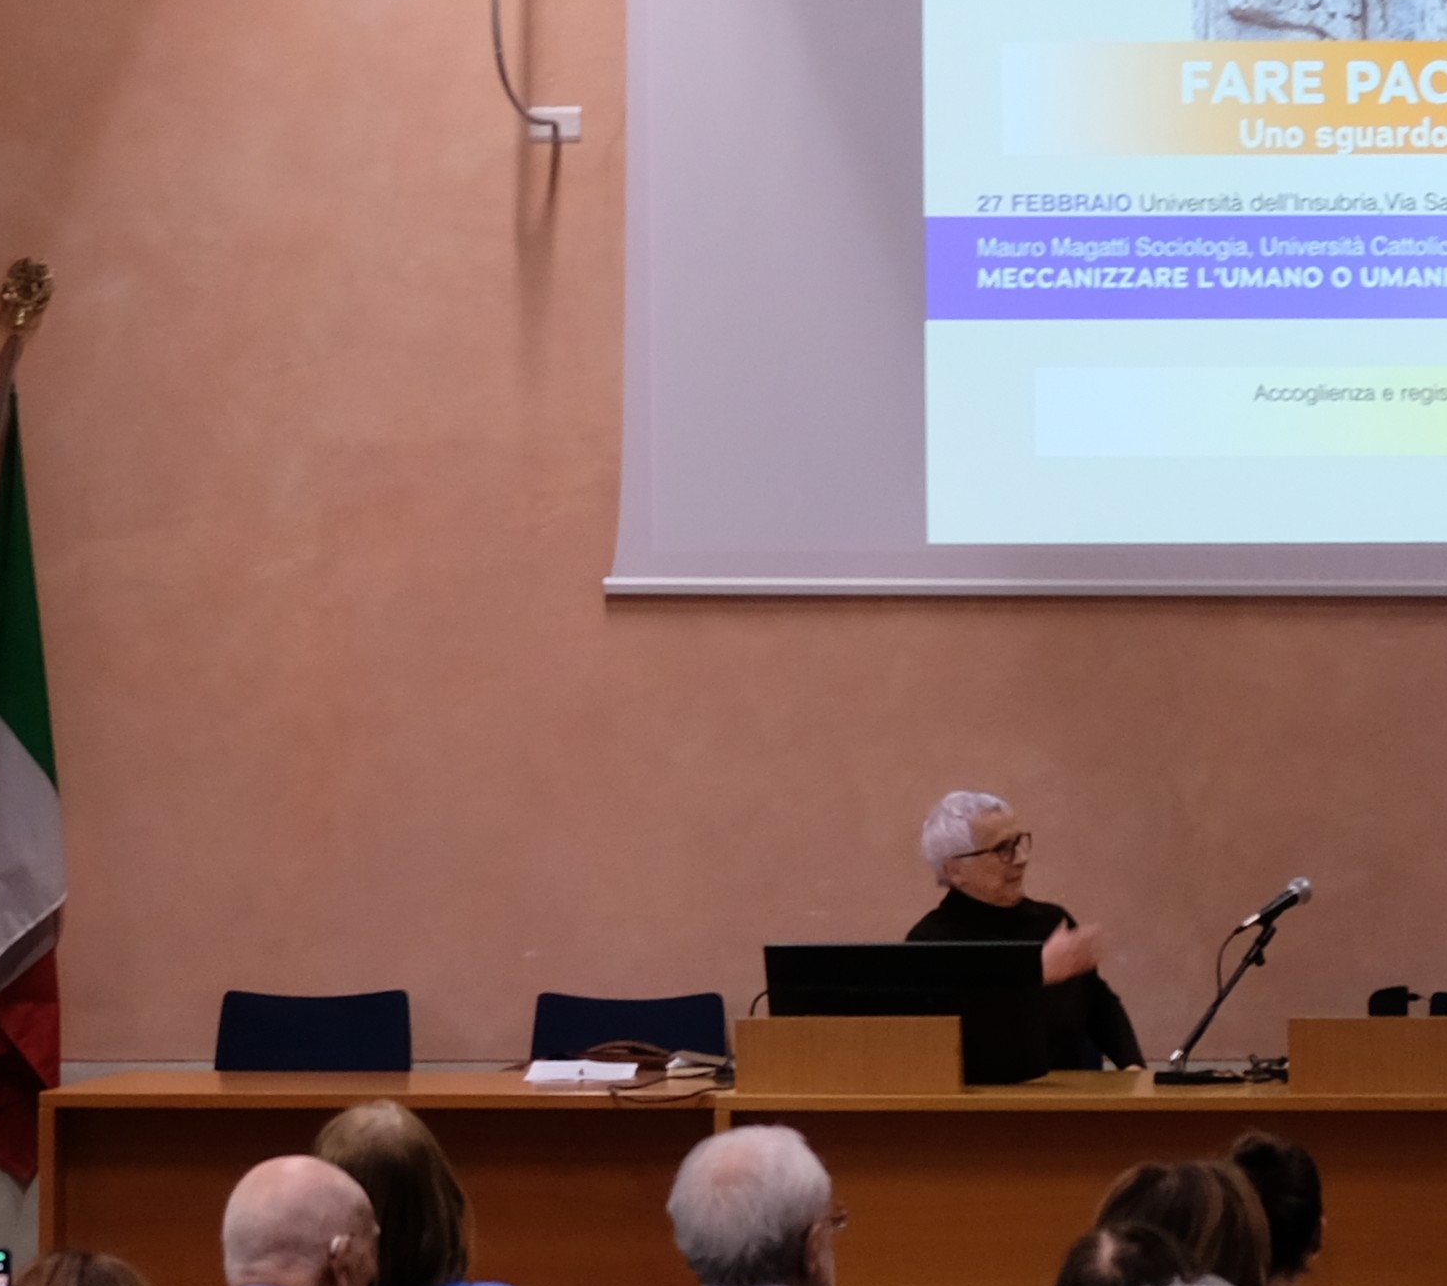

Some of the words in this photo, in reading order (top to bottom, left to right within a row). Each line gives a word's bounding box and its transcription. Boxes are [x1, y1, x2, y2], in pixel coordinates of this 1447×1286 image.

[1182, 61, 1324, 104] FARE
[1240, 119, 1304, 149] Uno
[977, 194, 1002, 214] 27
[1012, 194, 1132, 214] FEBBRAIO
[1140, 194, 1243, 214] Università
[977, 237, 1046, 257] Mauro
[1052, 237, 1130, 261] Magatti
[1135, 237, 1253, 261] Sociologia,
[1260, 236, 1364, 257] Università
[977, 268, 1188, 289] MECCANIZZARE
[1198, 268, 1323, 289] L'UMANO
[1331, 268, 1352, 289] O
[1254, 384, 1375, 405] Accoglienza
[1383, 388, 1394, 401] e
